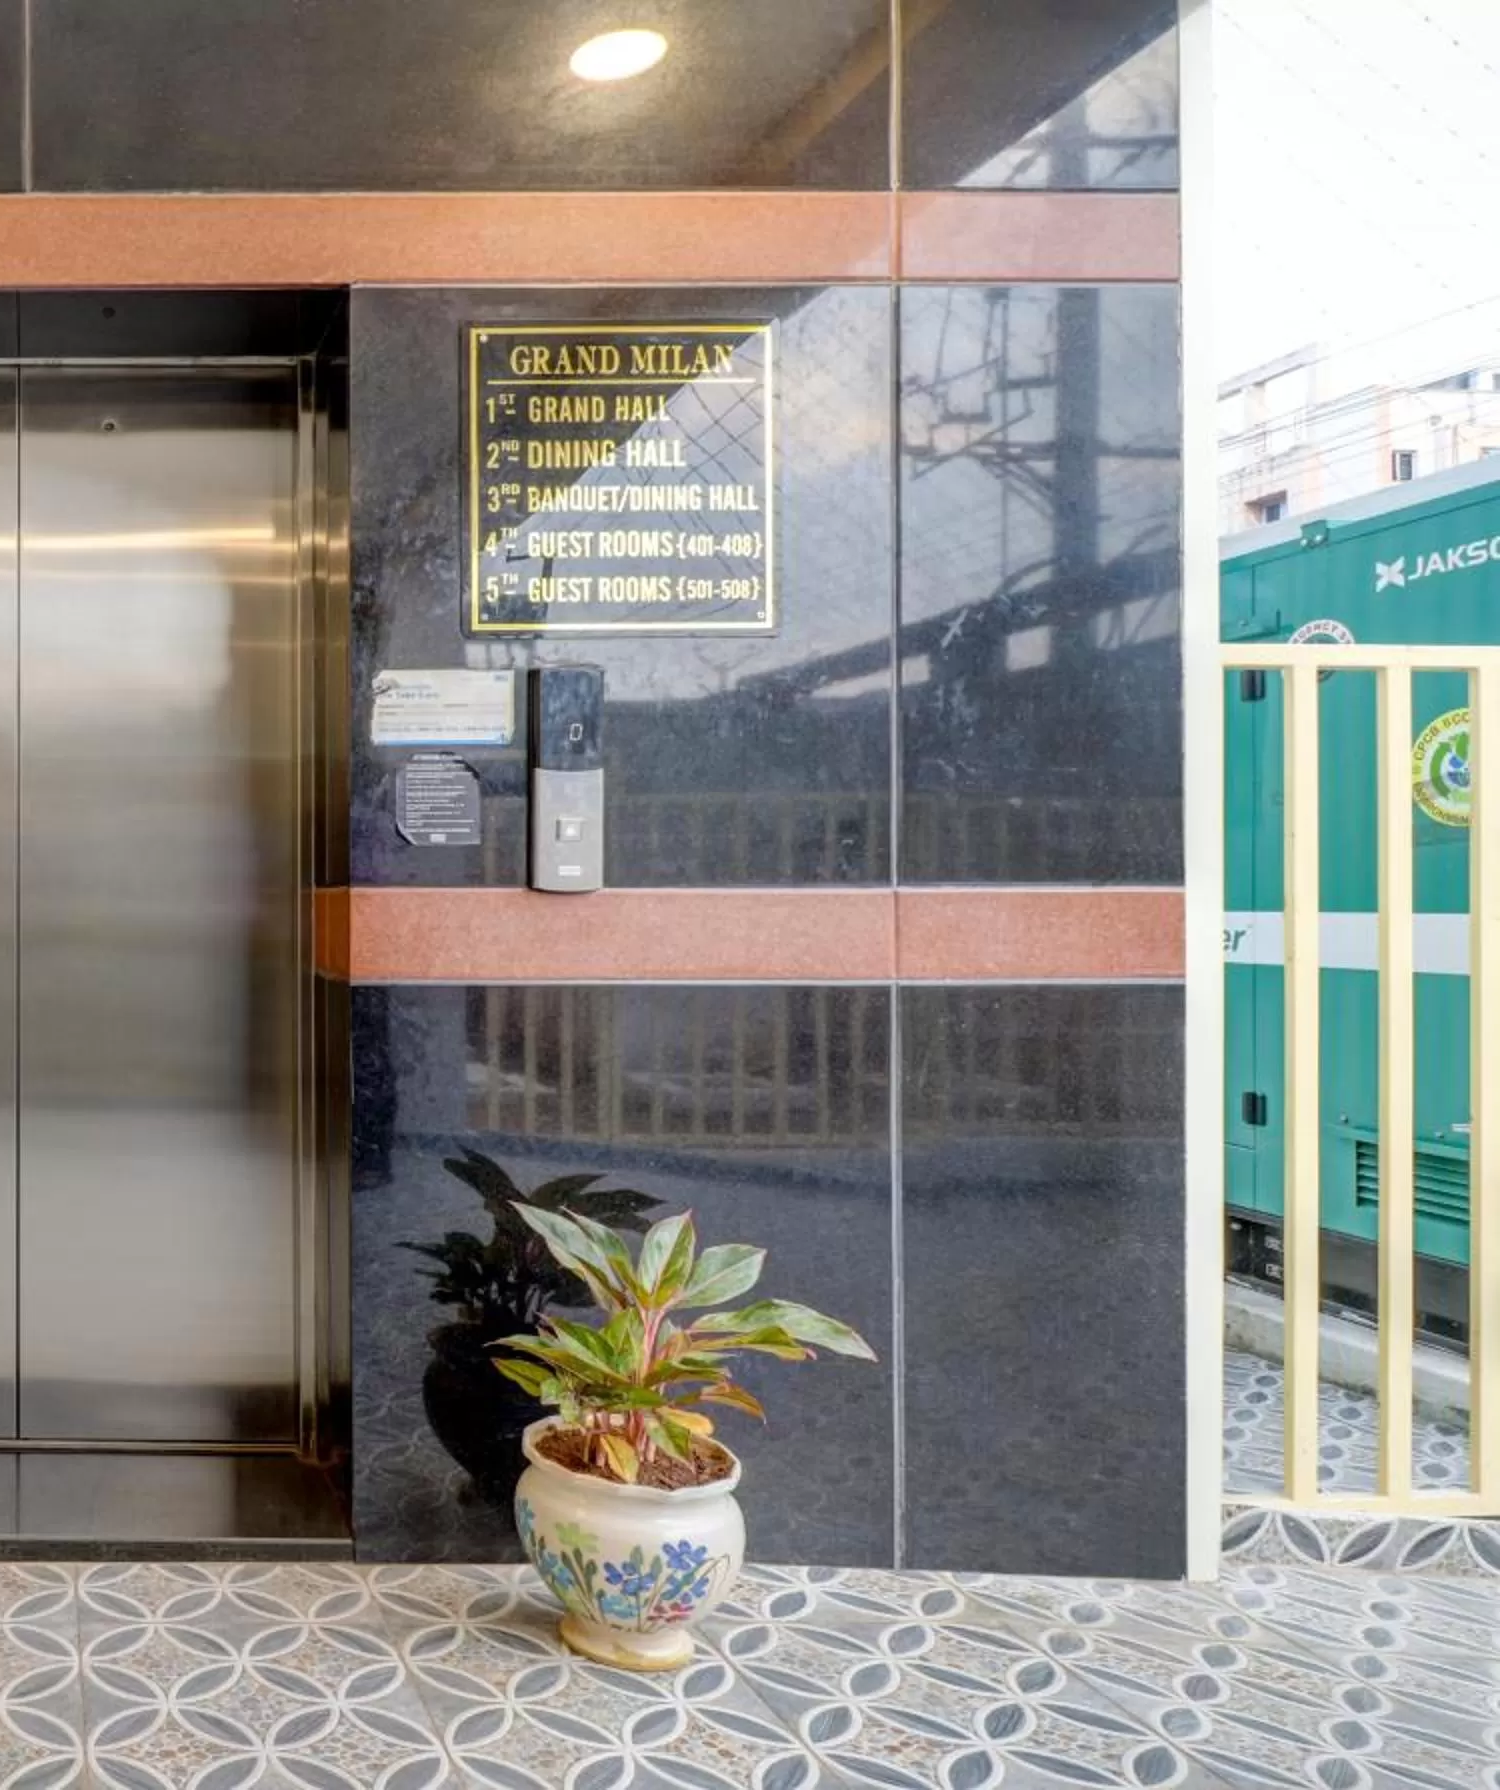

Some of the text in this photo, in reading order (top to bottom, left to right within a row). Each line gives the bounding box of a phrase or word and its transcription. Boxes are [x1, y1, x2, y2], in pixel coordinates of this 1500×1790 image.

[510, 344, 734, 376] GRAND MILAN
[528, 396, 605, 423] GRAND
[615, 395, 671, 422] HALL
[528, 440, 616, 469] DINING
[626, 440, 687, 467] HALL
[528, 485, 701, 513] BANQUET/DINING
[709, 485, 759, 511] HALL
[528, 531, 594, 559] GUEST
[599, 530, 673, 558] ROOMS
[528, 577, 594, 602] GUEST
[599, 576, 672, 602] ROOMS
[569, 723, 583, 741] 0
